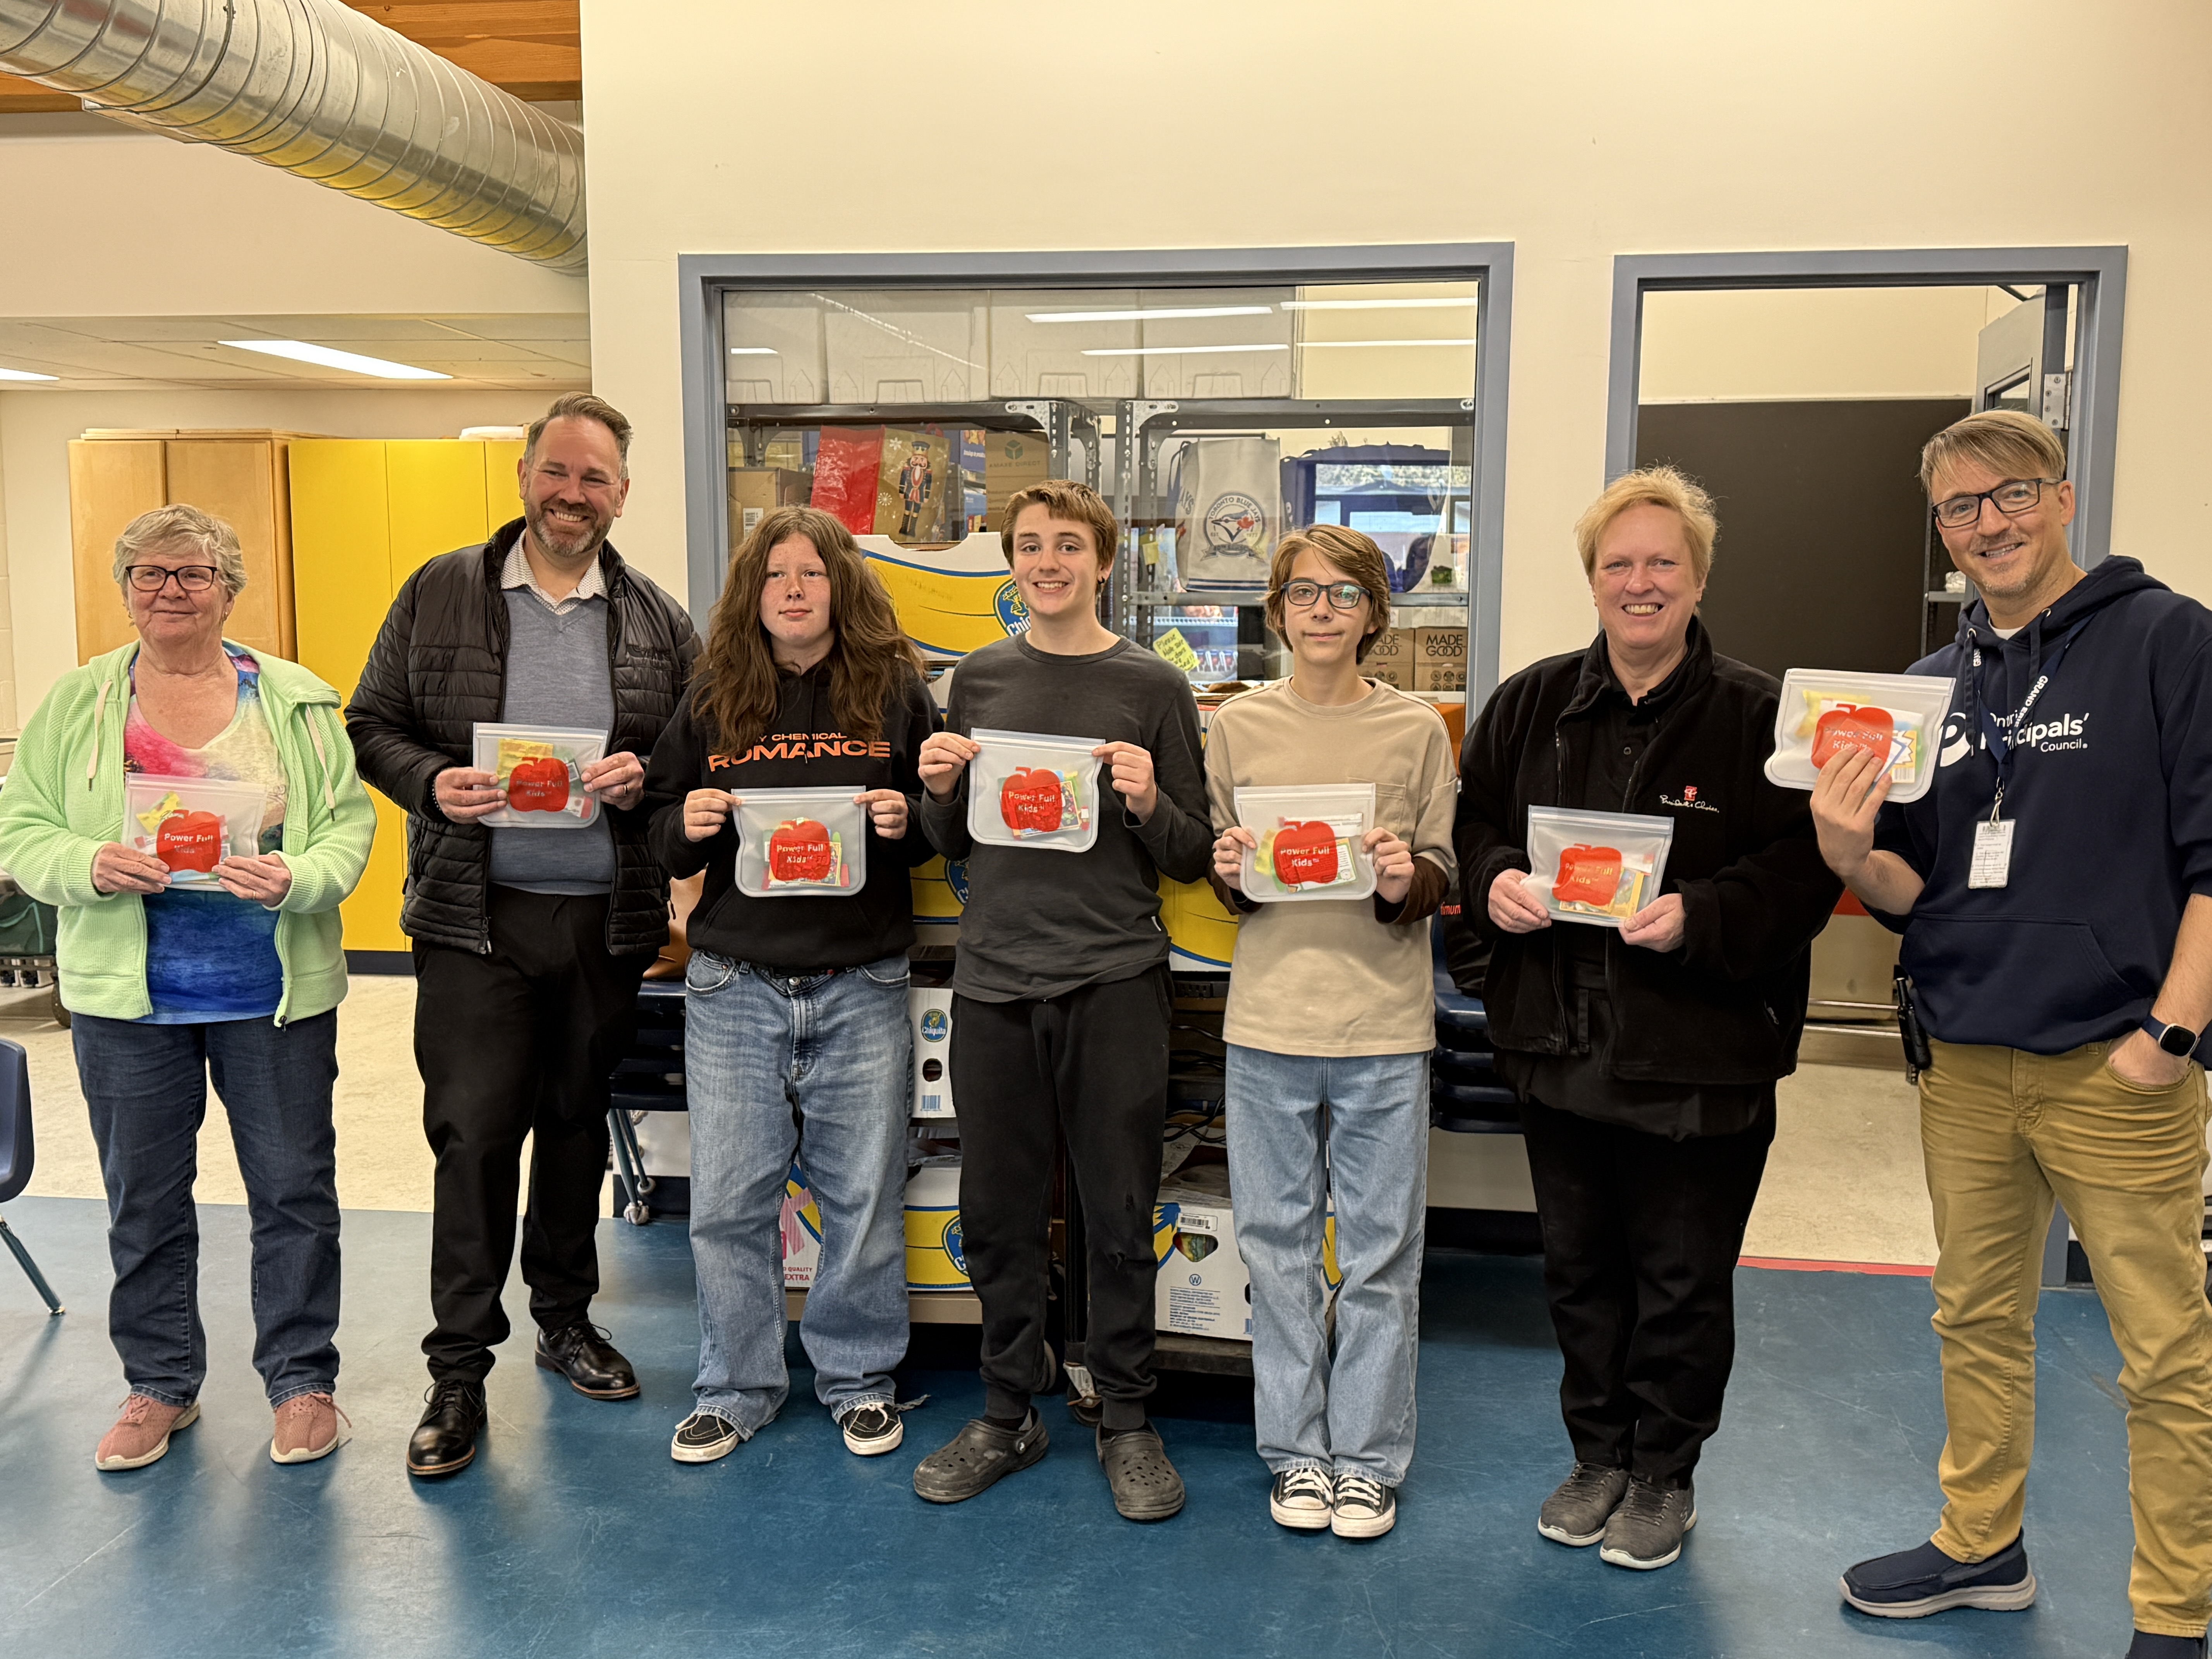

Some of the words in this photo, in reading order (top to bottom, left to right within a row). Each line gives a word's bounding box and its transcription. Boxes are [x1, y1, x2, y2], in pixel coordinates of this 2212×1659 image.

[1209, 497, 1235, 520] TORONTO
[1236, 497, 1252, 509] BLUE
[1250, 507, 1261, 523] JAYS
[1426, 634, 1463, 646] MADE
[1426, 646, 1463, 657] GOOD
[2025, 675, 2048, 706] GRAND
[771, 732, 847, 741] CHEMICAL
[708, 740, 890, 772] ROMANCE
[1008, 791, 1037, 801] Power
[164, 833, 194, 842] Power
[776, 844, 804, 852] Power
[807, 843, 824, 852] Full
[1280, 847, 1310, 855] Power
[1312, 846, 1330, 855] Full
